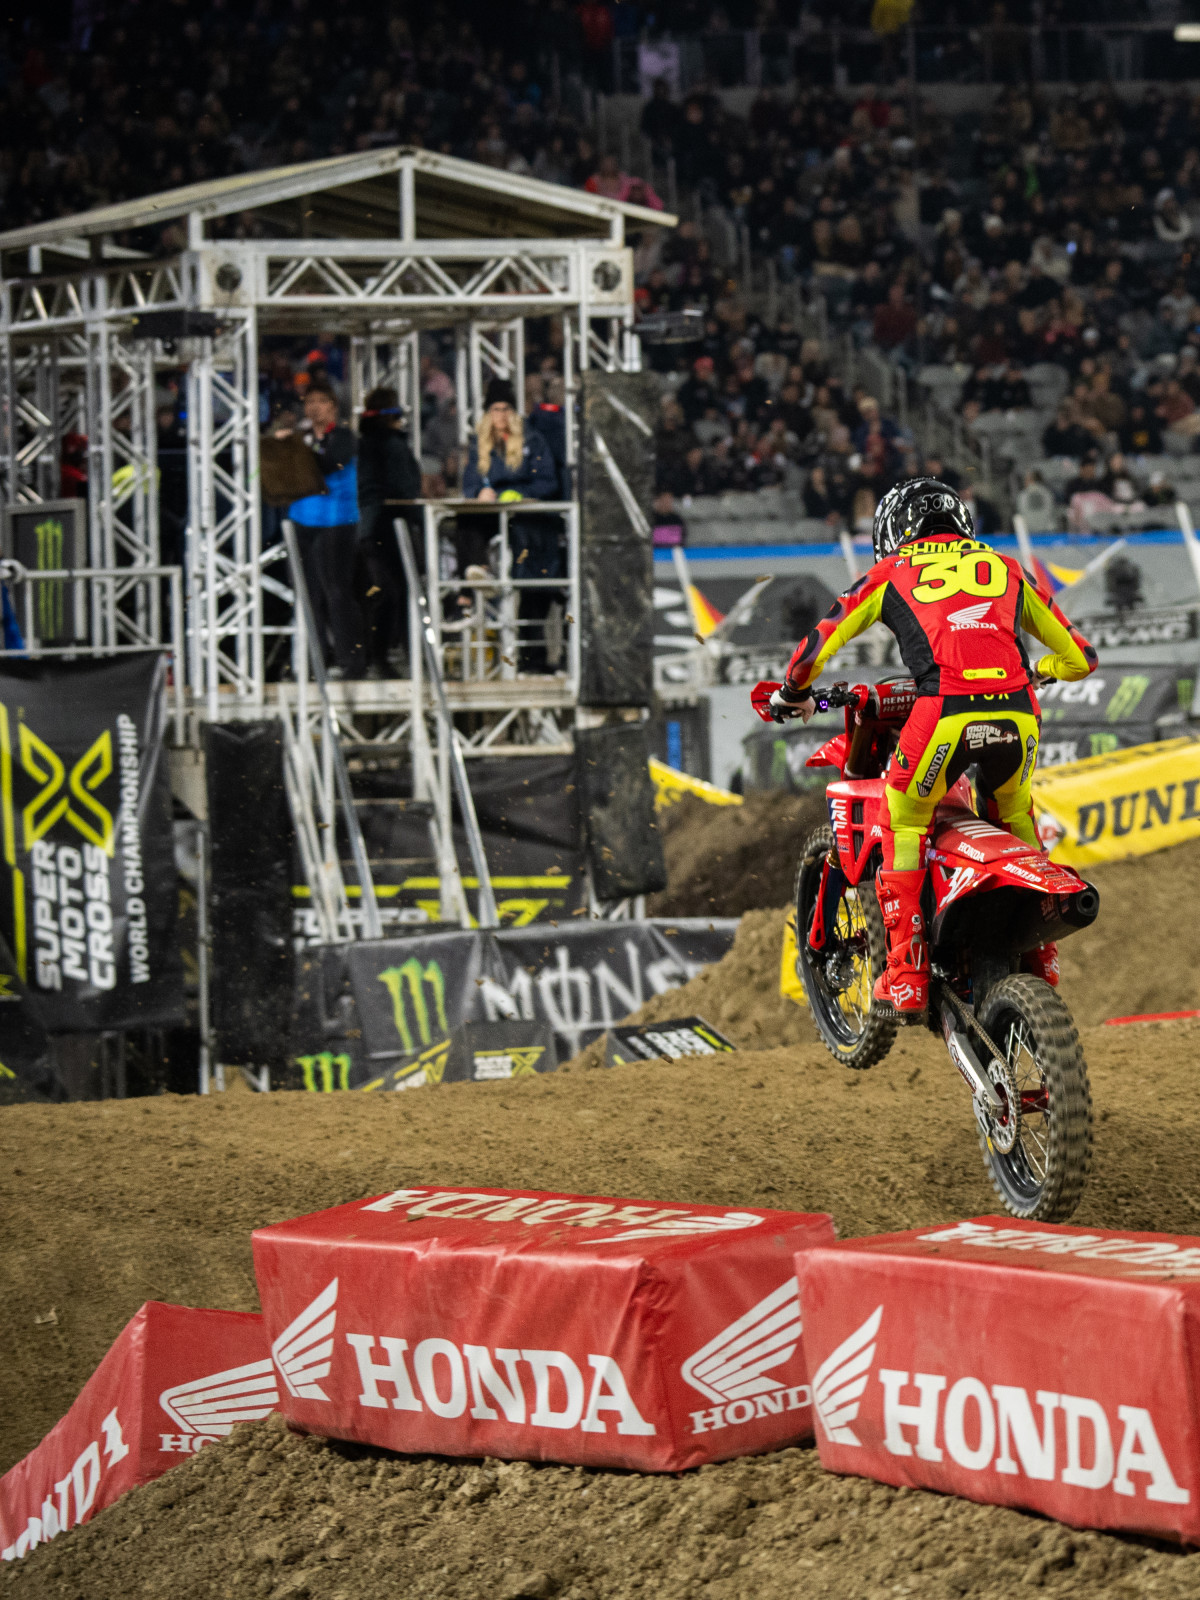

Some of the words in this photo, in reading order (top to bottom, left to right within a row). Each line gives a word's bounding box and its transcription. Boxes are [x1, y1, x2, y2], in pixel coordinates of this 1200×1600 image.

[910, 551, 1010, 604] 30
[949, 621, 999, 632] HONDA
[922, 744, 951, 788] HONDA
[116, 713, 145, 895] CHAMPIONSHIP
[830, 798, 848, 832] CRF
[957, 841, 986, 863] HONDA
[1001, 862, 1042, 883] DUNLOP
[31, 839, 63, 992] SUPER
[56, 845, 91, 982] MOTO
[82, 840, 117, 992] CROSS
[884, 899, 900, 913] FOX
[125, 896, 151, 985] WORLD
[360, 1189, 692, 1228] HONDA
[345, 1332, 656, 1436] HONDA
[878, 1367, 1191, 1504] HONDA
